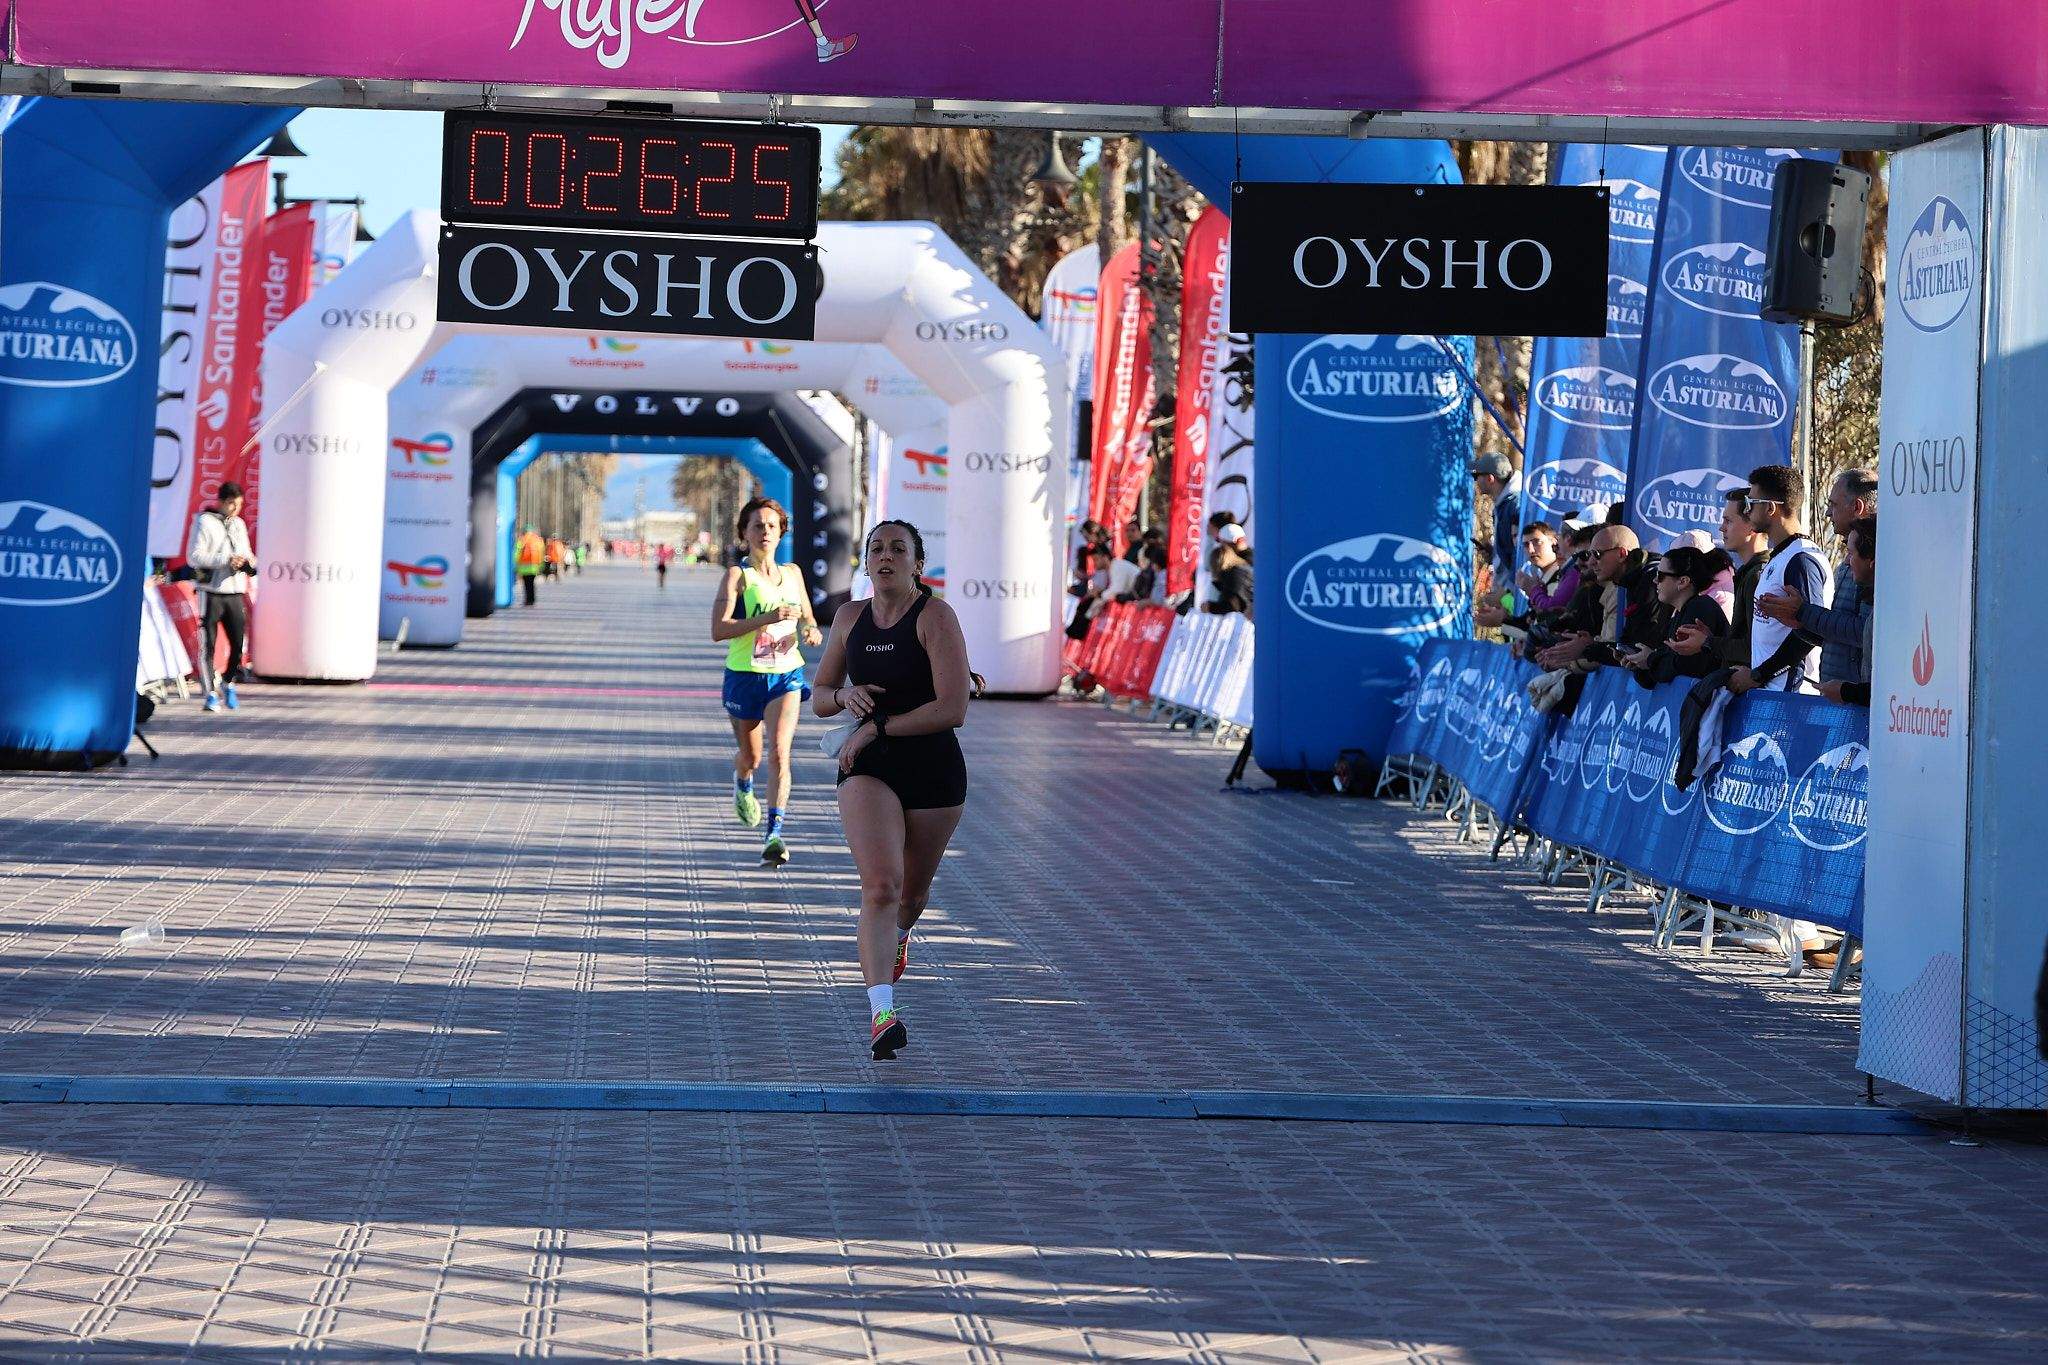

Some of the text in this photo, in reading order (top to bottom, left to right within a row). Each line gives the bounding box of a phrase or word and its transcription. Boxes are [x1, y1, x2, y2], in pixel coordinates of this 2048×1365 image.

[470, 130, 790, 219] 00:26:25
[458, 242, 798, 324] OYSHO
[1293, 236, 1552, 291] OYSHO
[1671, 261, 1767, 303] ASTURIA
[1903, 252, 1970, 302] ASTURIANA
[204, 212, 244, 385] Santander
[321, 308, 416, 331] OYSHO
[915, 320, 1008, 341] OYSHO
[1328, 354, 1395, 367] CENTRAL
[1682, 374, 1727, 388] CENTRAL
[551, 393, 740, 417] VOLVO
[1181, 238, 1230, 562] Sports Santander
[1658, 374, 1779, 419] ASTURIANA
[965, 451, 1052, 474] OYSHO
[1890, 436, 1966, 497] OYSHO
[1669, 490, 1714, 501] CENTRAL
[865, 643, 894, 652] OYSHO
[1889, 695, 1952, 738] Santander
